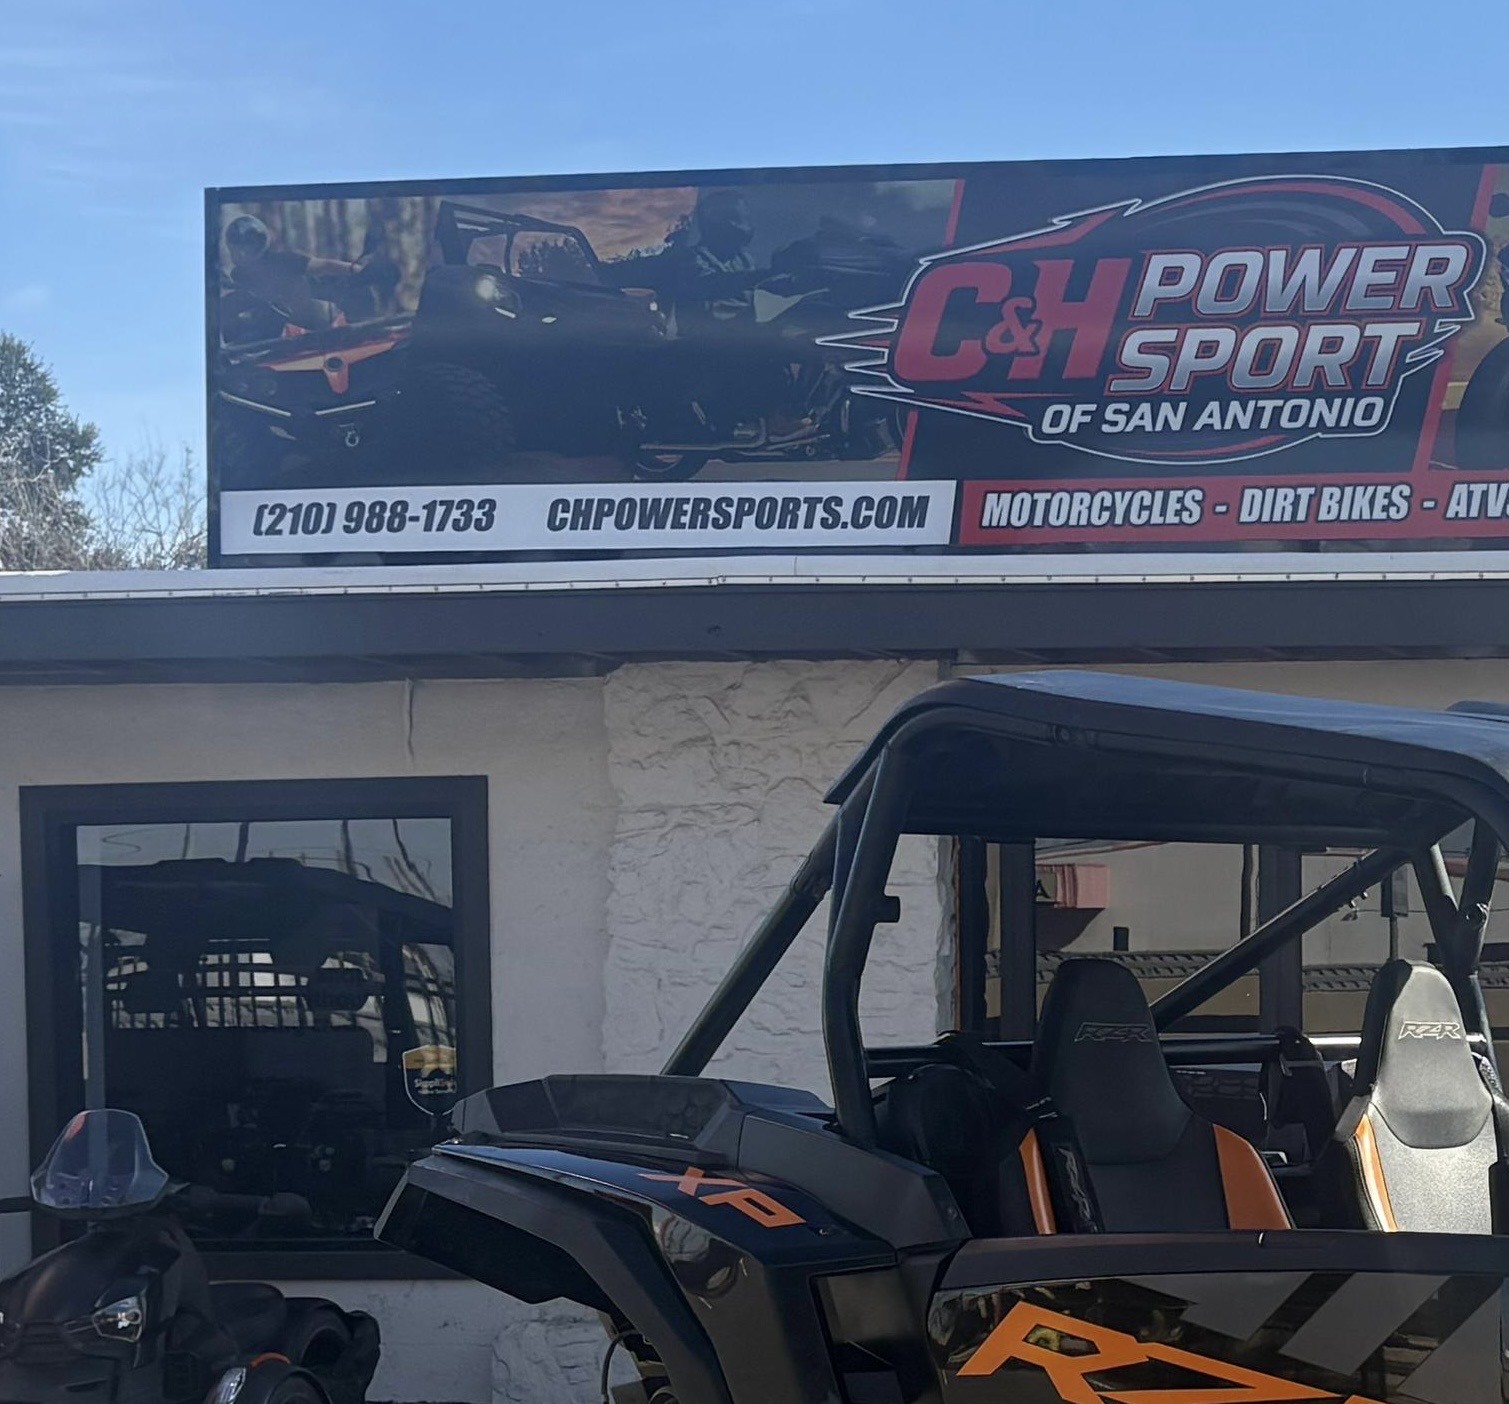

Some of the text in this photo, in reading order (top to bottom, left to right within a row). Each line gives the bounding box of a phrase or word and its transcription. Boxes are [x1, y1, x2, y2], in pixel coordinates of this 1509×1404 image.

[1131, 243, 1471, 320] POWER
[893, 258, 1131, 383] C&H
[1109, 321, 1424, 394] SPORT
[1041, 396, 1385, 435] OF SAN ANTONIO
[253, 499, 497, 536] (210) 988-1733
[547, 495, 931, 532] CHPOWERSPORTS.COM
[981, 488, 1204, 527] MOTORCYCLES
[1238, 487, 1317, 524] DIRT
[1318, 483, 1411, 523] BIKES
[1398, 1020, 1461, 1040] RZR
[636, 1165, 807, 1228] XP
